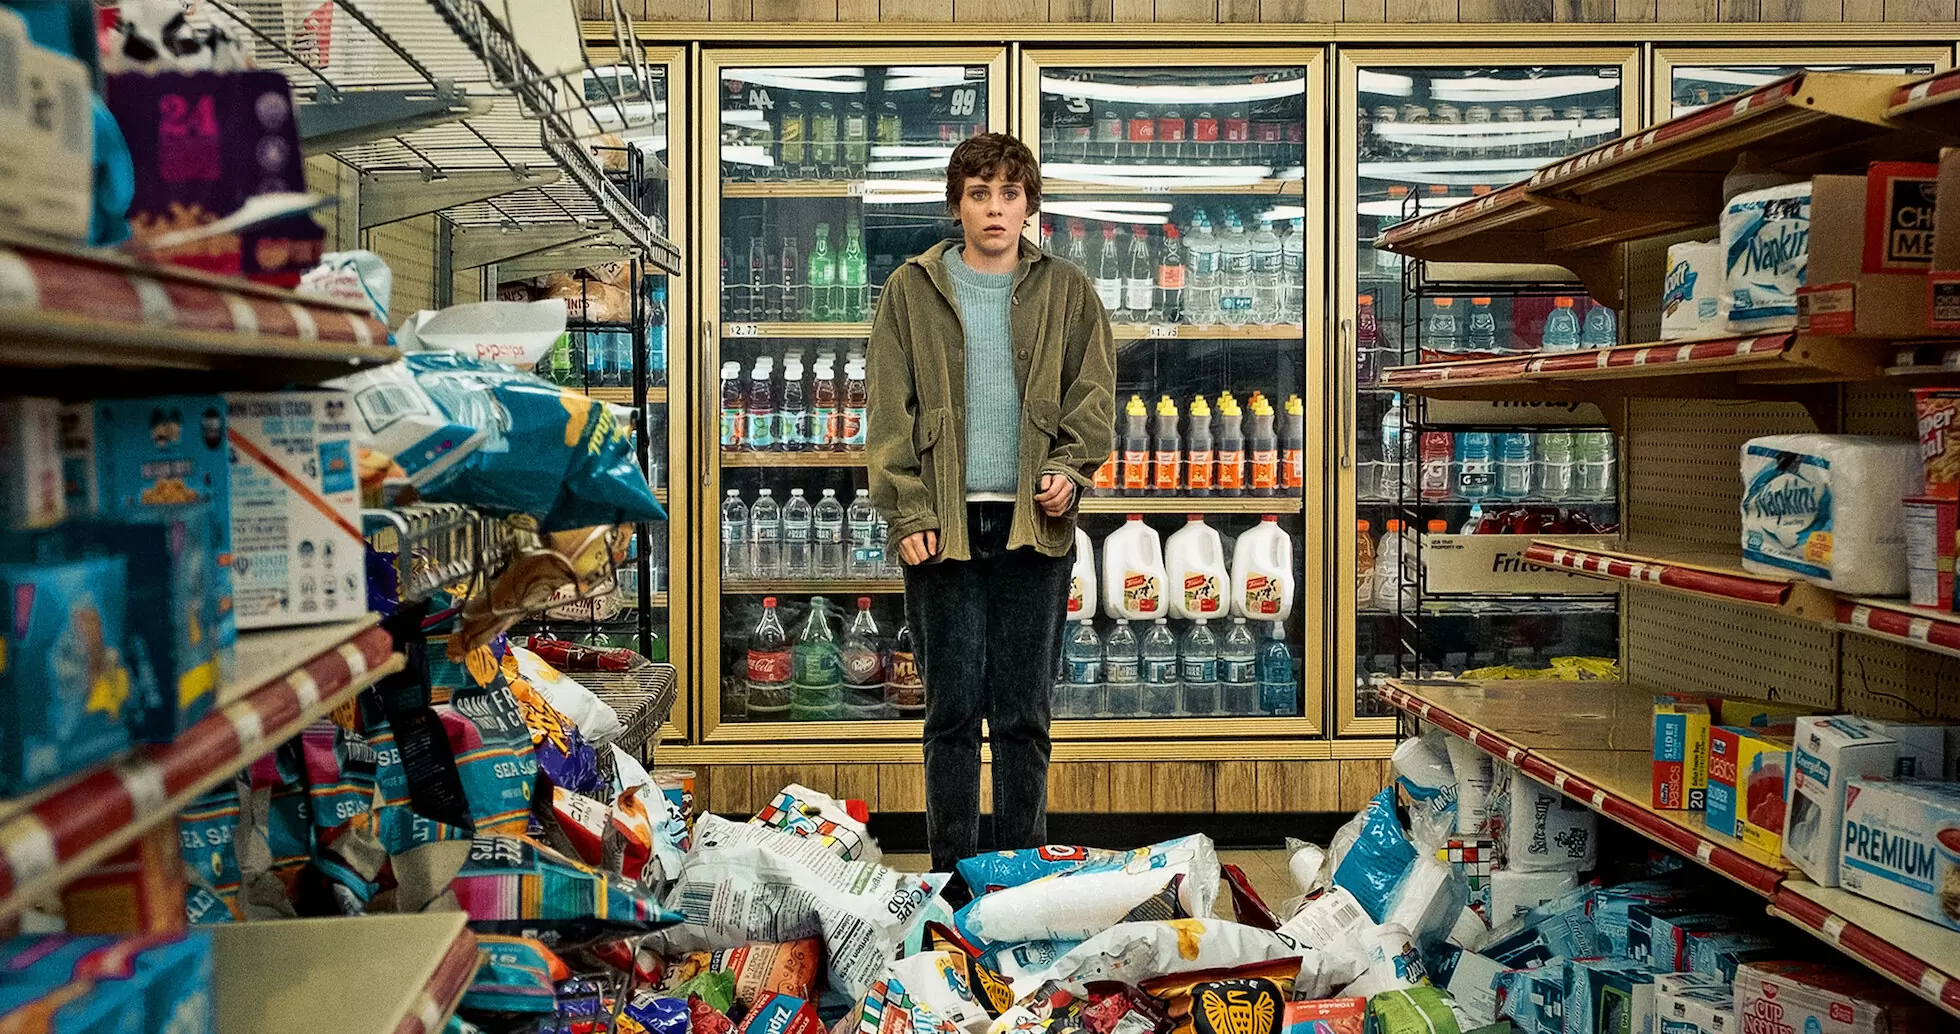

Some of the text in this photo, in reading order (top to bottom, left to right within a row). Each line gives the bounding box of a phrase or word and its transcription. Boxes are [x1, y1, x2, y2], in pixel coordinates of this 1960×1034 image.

[159, 95, 216, 136] 24
[950, 89, 976, 116] 99
[1063, 95, 1090, 114] 3
[1897, 206, 1936, 256] CH ME
[1743, 221, 1810, 277] Napkin
[1665, 261, 1688, 293] cott
[731, 325, 758, 336] $2.77
[1755, 479, 1818, 525] Napkins
[1664, 722, 1674, 760] SLIDER
[495, 761, 520, 779] SEA
[1709, 756, 1736, 783] basics
[1667, 765, 1682, 809] basics
[1690, 790, 1704, 809] 20
[1846, 820, 1937, 881] PREMIUM
[887, 889, 910, 915] COD
[896, 889, 924, 926] CAPE
[839, 927, 875, 980] Nutrition Facts
[1756, 1001, 1783, 1024] CUP
